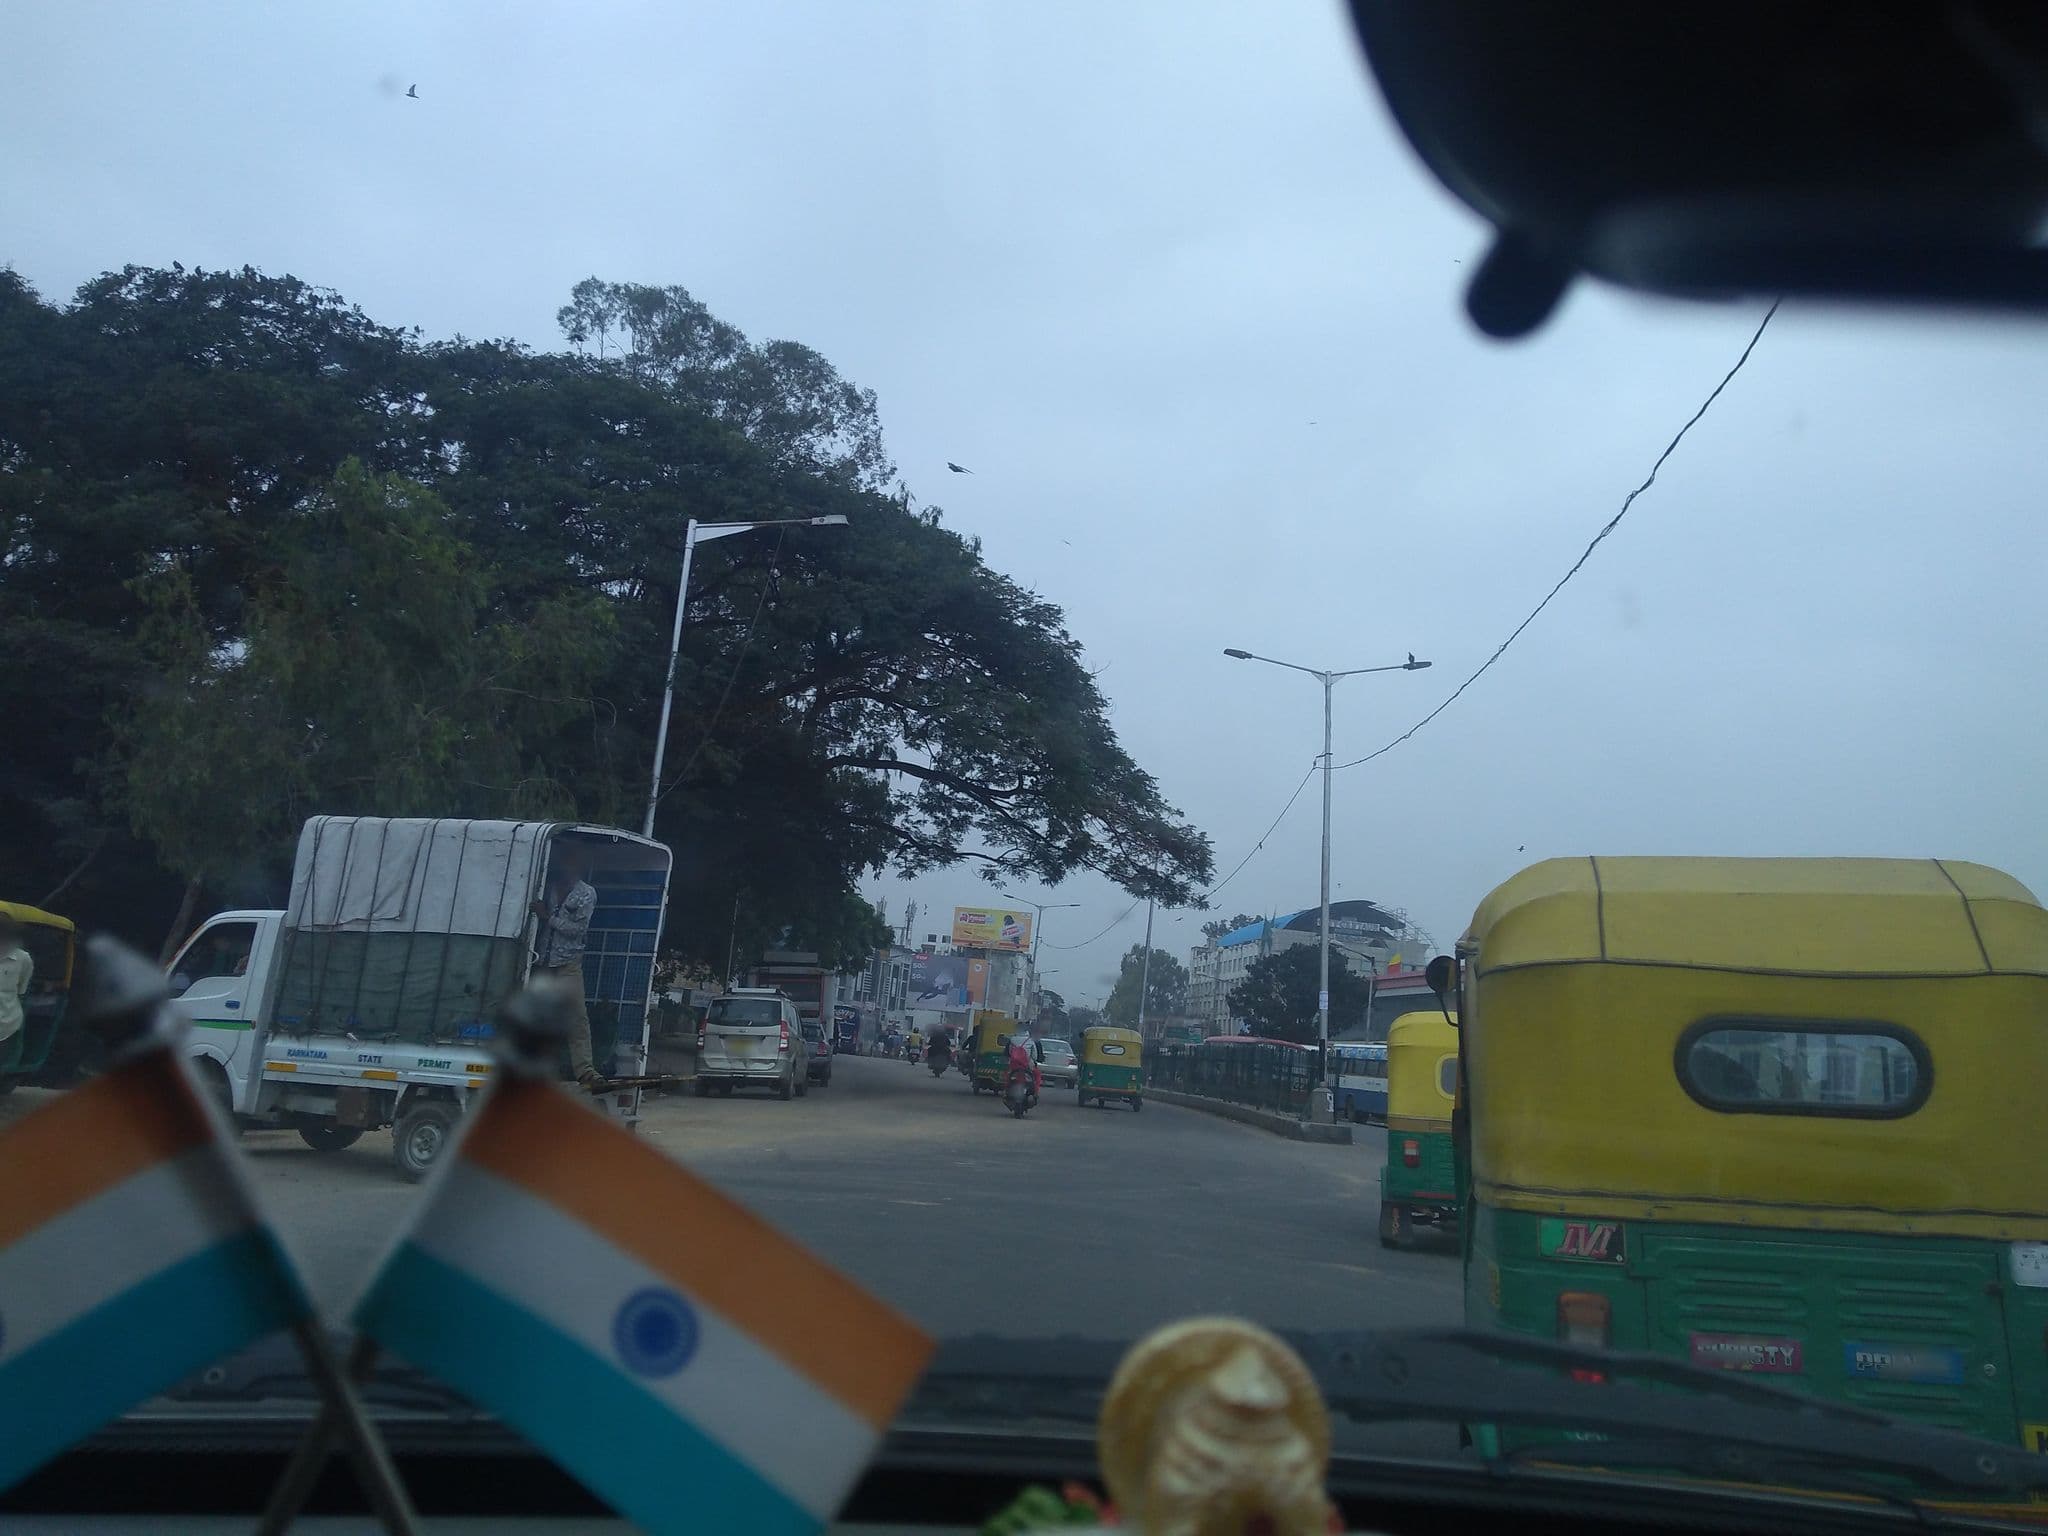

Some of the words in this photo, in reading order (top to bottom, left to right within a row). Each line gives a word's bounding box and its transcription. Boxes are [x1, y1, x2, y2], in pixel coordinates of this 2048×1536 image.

[287, 1048, 328, 1060] KARNATAKA
[357, 1054, 383, 1064] STATE
[417, 1058, 452, 1070] PERMIT
